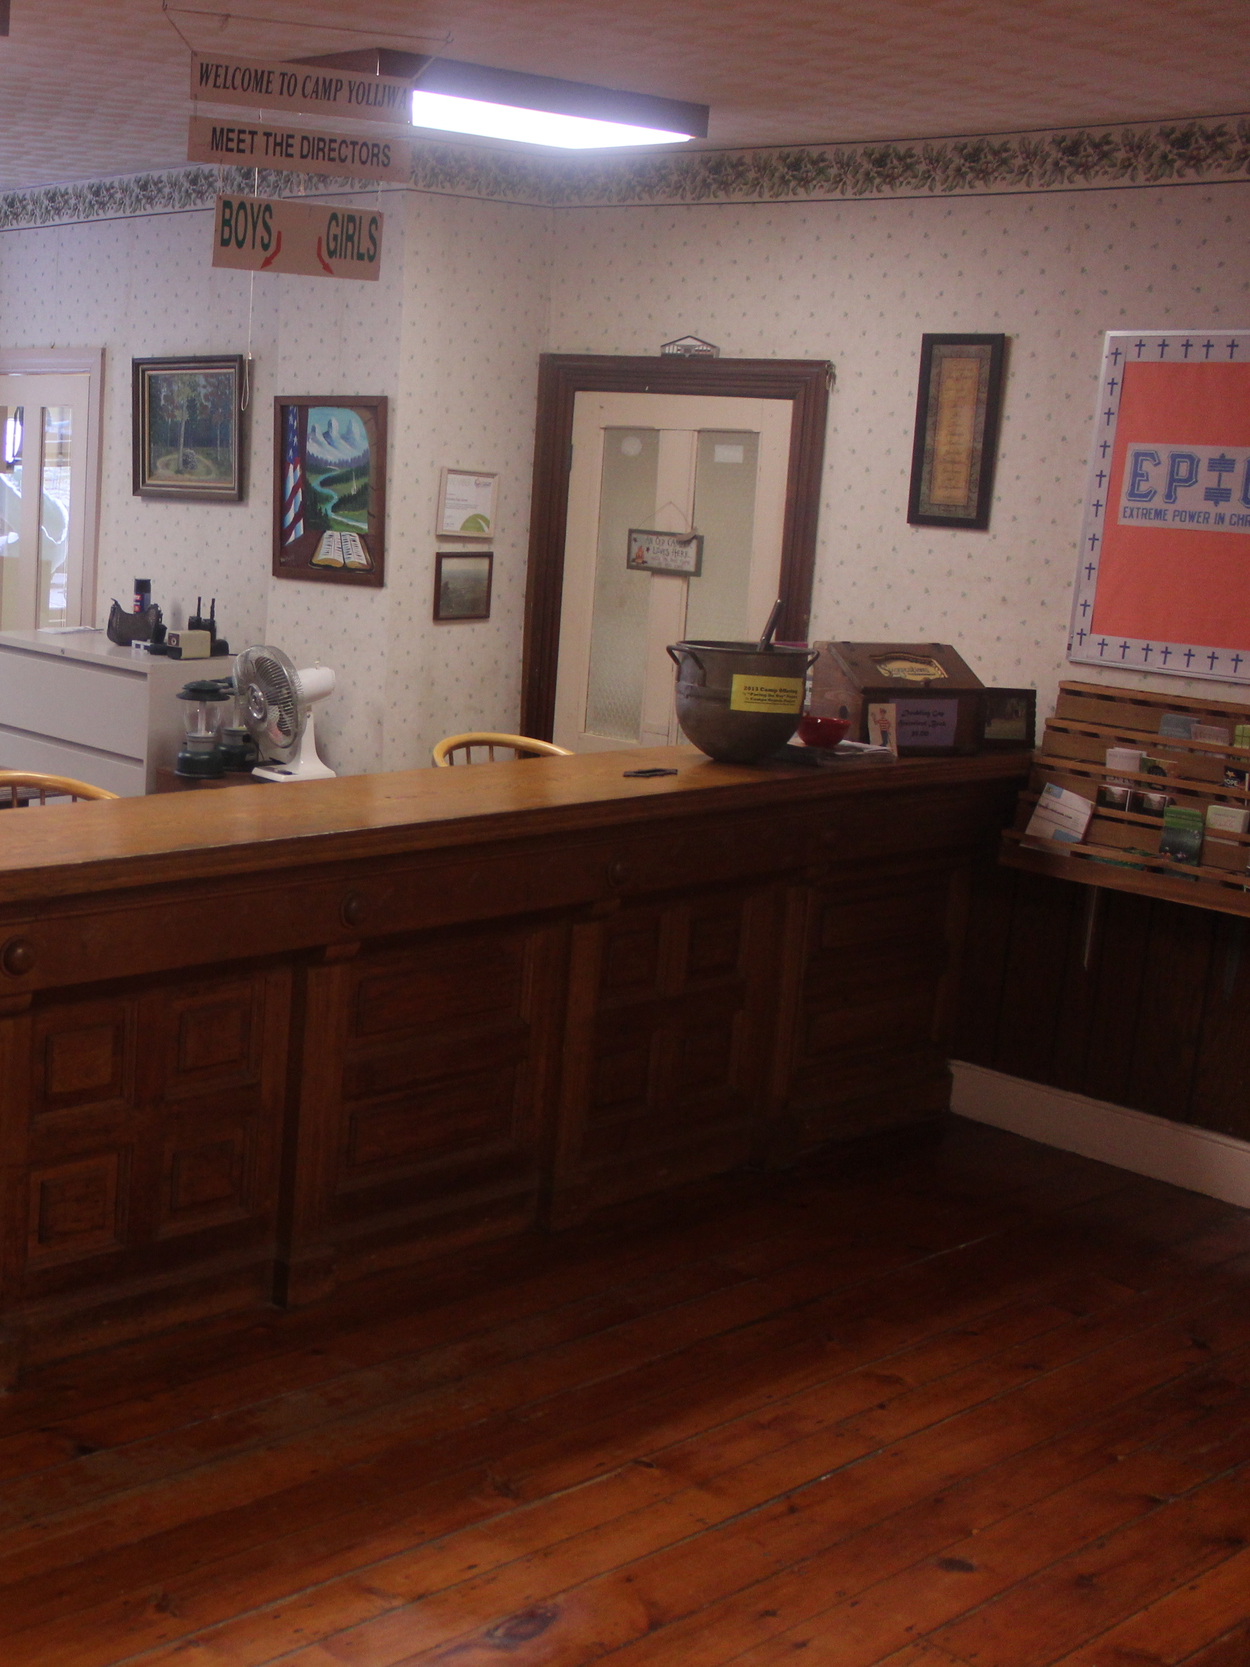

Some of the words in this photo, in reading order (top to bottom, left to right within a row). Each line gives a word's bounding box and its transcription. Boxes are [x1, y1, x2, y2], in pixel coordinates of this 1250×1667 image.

[199, 62, 274, 96] WELCOME
[279, 73, 298, 98] TO
[301, 74, 343, 102] CAMP
[347, 80, 408, 111] YOLIJWA
[210, 126, 258, 155] MEET
[263, 132, 295, 159] THE
[300, 135, 391, 168] DIRECTORS
[220, 199, 273, 252] BOYS
[326, 211, 379, 263] GIRLS
[1122, 505, 1169, 522] EXTREME
[1172, 509, 1211, 525] POWER
[1214, 512, 1226, 526] IN
